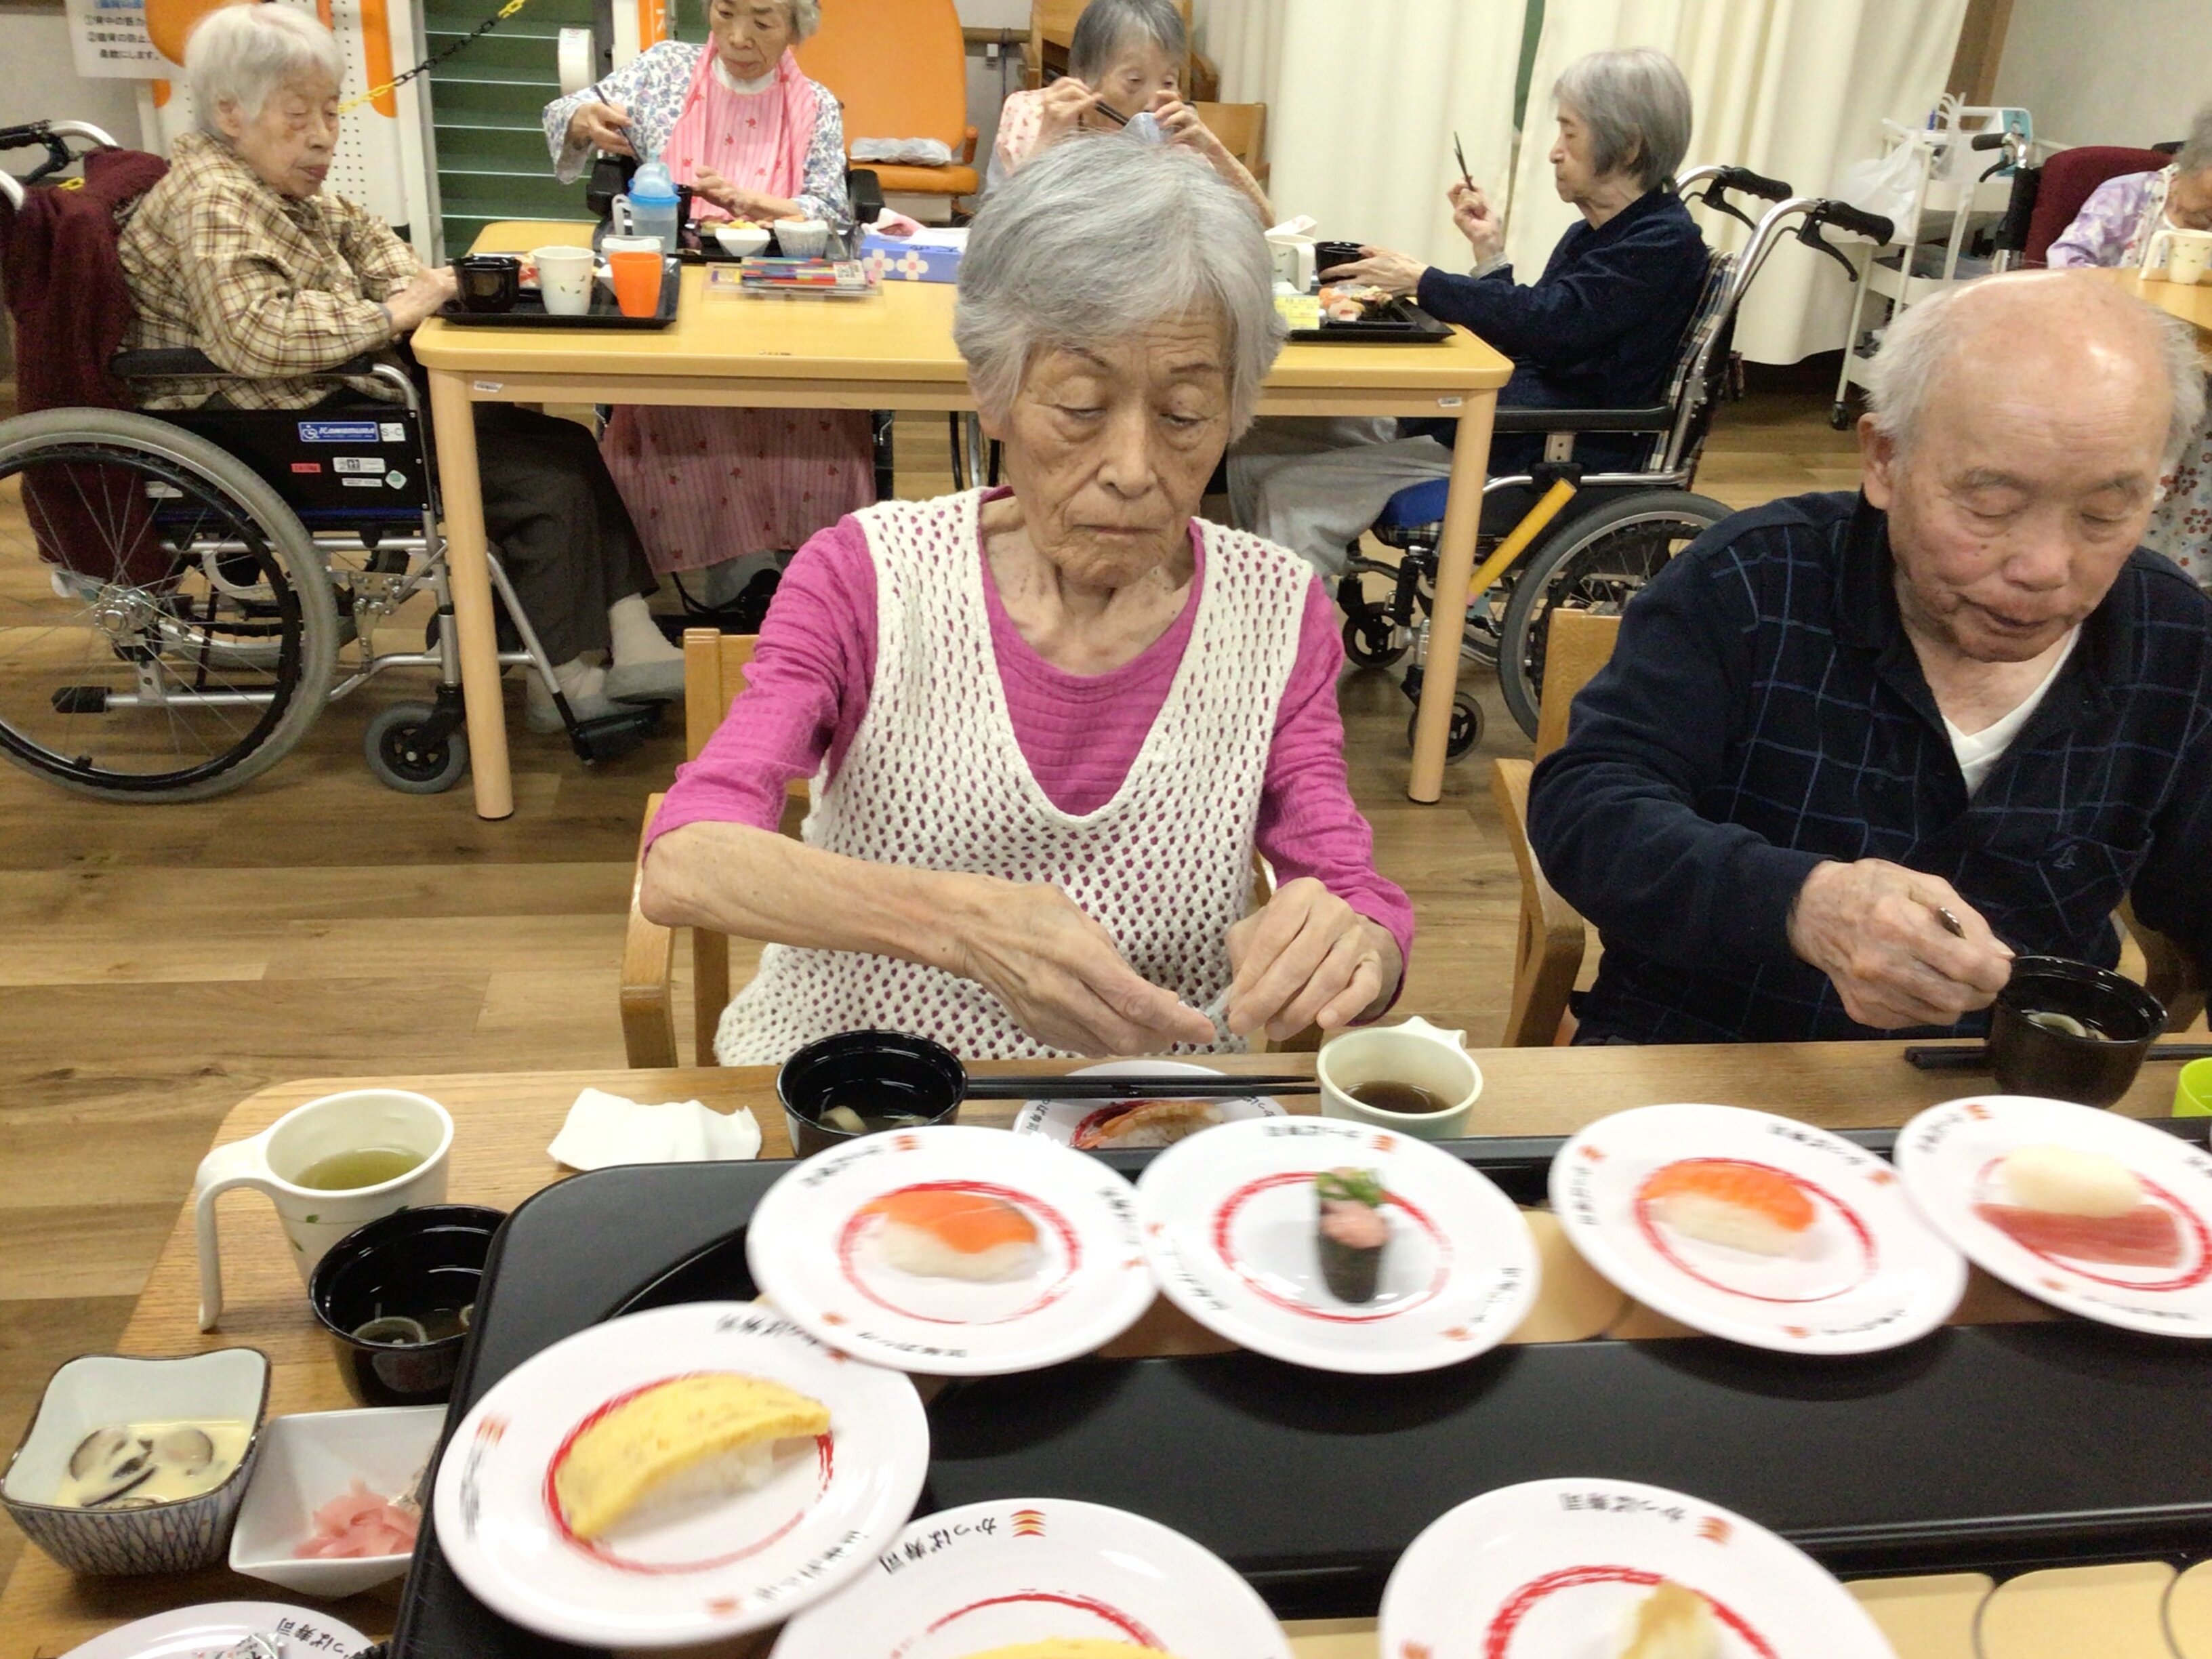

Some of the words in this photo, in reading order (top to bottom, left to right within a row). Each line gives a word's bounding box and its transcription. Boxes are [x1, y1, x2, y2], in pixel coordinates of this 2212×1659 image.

[878, 1517, 997, 1574] かっぱ寿司
[277, 1618, 350, 1659] っぱ寿司
